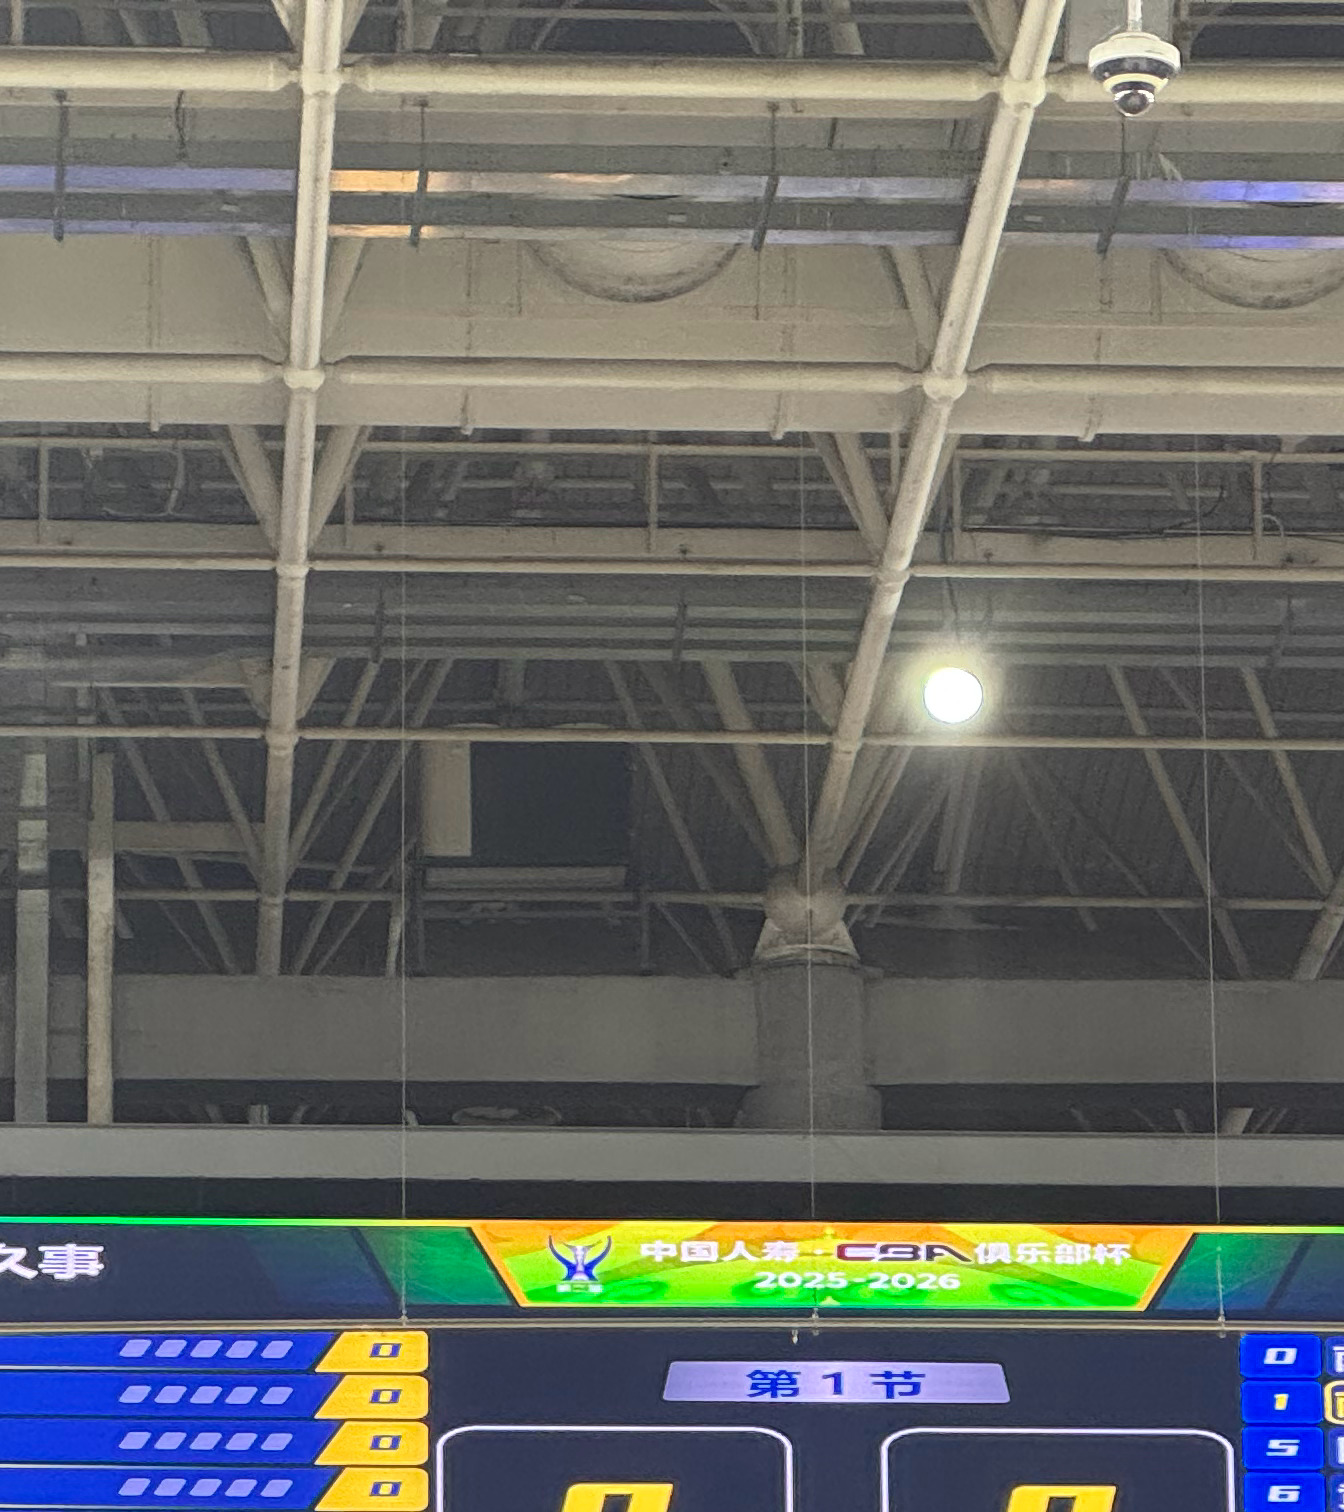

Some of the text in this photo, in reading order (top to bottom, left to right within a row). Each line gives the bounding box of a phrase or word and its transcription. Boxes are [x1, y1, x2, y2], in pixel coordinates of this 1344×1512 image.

[755, 1271, 961, 1290] 2025-2026
[370, 1343, 401, 1358] 0
[1263, 1347, 1297, 1365] 0
[370, 1389, 401, 1404] 0
[1274, 1393, 1289, 1411] 1
[371, 1435, 401, 1450] 0
[1267, 1439, 1299, 1457] 5
[371, 1481, 401, 1497] 0
[1267, 1485, 1300, 1503] 6
